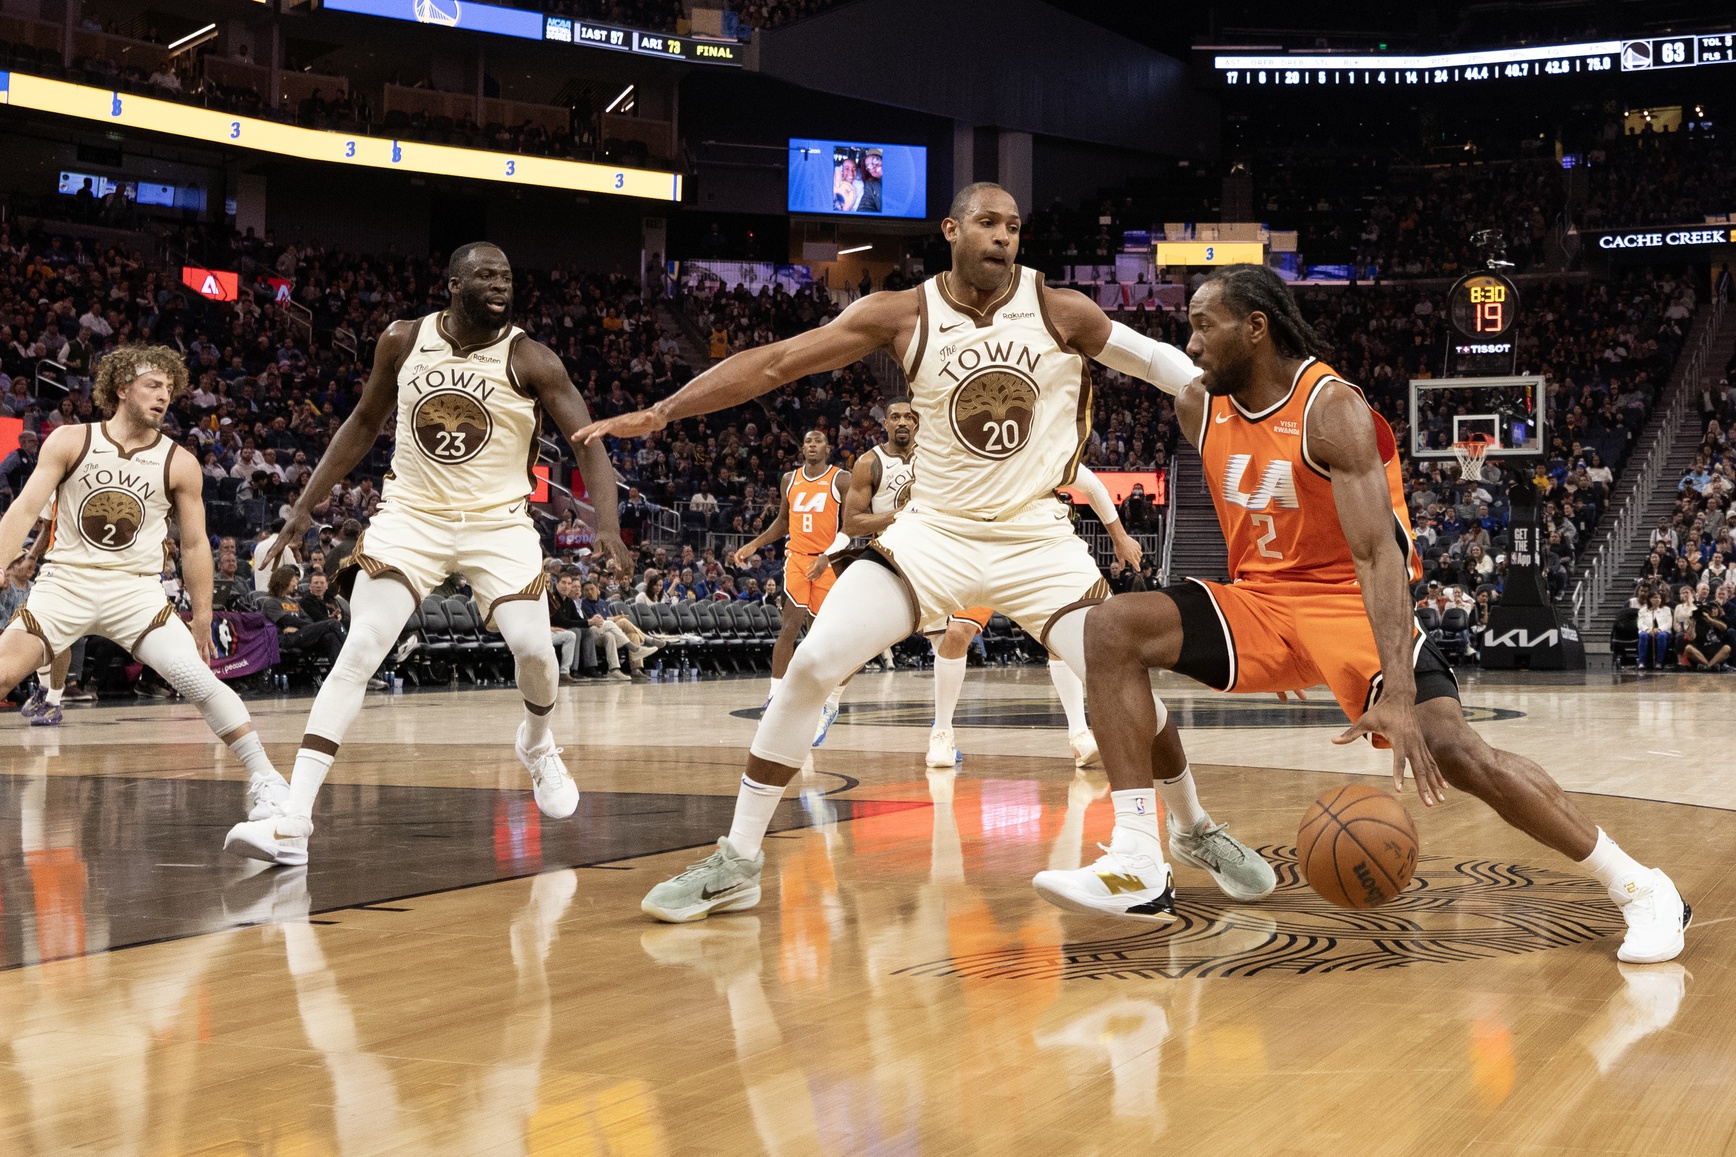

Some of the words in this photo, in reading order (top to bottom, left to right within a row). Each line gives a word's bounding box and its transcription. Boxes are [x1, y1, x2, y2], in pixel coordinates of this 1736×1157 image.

[610, 30, 624, 45] 57
[641, 37, 662, 50] ARI
[667, 40, 680, 54] 73
[696, 45, 733, 58] FINAL
[1662, 42, 1685, 63] 63
[1702, 52, 1720, 61] FLS
[1726, 49, 1733, 61] 1
[1226, 71, 1238, 84] 17
[1258, 71, 1267, 84] 6
[1285, 71, 1300, 84] 20
[1318, 71, 1326, 84] 5
[1348, 71, 1355, 84] 1
[1378, 71, 1386, 84] 4
[1405, 71, 1418, 84] 14
[1434, 70, 1448, 83] 24
[1464, 66, 1489, 80] 44.4
[1505, 63, 1529, 77] 40.7
[1545, 60, 1570, 74] 42.6
[1587, 57, 1611, 71] 75.0
[230, 122, 241, 139] 3
[345, 141, 356, 157] 3
[505, 160, 515, 176] 3
[614, 173, 624, 189] 3
[1599, 233, 1663, 249] CACHE
[1665, 230, 1726, 245] CREEK
[1205, 247, 1214, 261] 3
[1470, 286, 1506, 303] 8:30
[1002, 311, 1035, 321] Rakuten
[1476, 303, 1502, 332] 19
[939, 344, 957, 363] The
[1470, 343, 1511, 354] TISSOT
[473, 353, 501, 364] Rakuten
[938, 340, 1041, 382] TOWN
[412, 364, 429, 376] The
[407, 368, 495, 401] TOWN
[1280, 420, 1297, 428] VISIT
[982, 419, 1019, 451] 20
[434, 431, 466, 457] 23
[83, 462, 99, 473] The
[78, 469, 156, 500] TOWN
[885, 470, 915, 491] TO
[1222, 453, 1300, 511] LA
[792, 492, 828, 513] LA
[802, 514, 813, 533] 8
[101, 523, 116, 545] 2
[1250, 513, 1283, 560] 2
[1514, 528, 1528, 540] GET
[1514, 540, 1528, 552] THE
[1517, 552, 1531, 567] App
[224, 658, 249, 675] peacock
